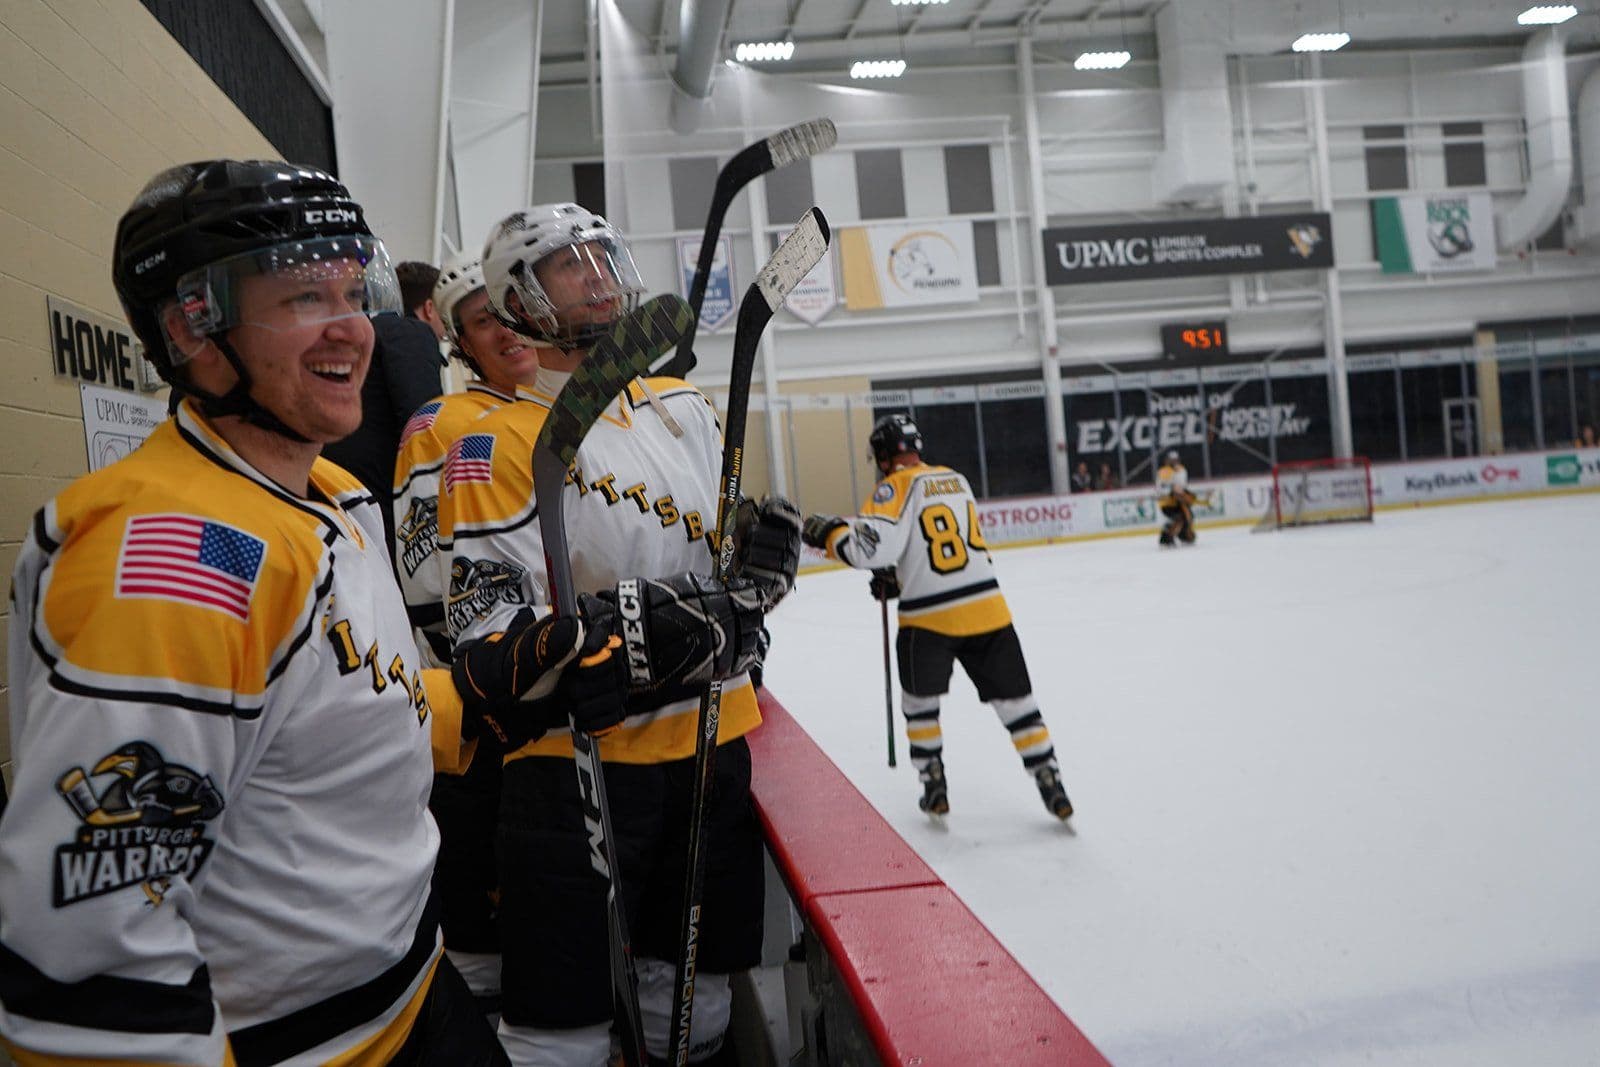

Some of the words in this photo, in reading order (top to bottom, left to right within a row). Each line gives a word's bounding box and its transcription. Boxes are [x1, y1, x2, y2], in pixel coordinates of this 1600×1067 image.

[305, 209, 357, 224] CCM
[135, 251, 166, 275] CCM
[1056, 238, 1150, 269] UPMC
[53, 310, 135, 391] HOME
[95, 398, 129, 425] UPMC
[1077, 411, 1205, 453] EXCEL
[1405, 471, 1478, 492] KeyBank
[565, 456, 720, 555] ITTSB
[322, 594, 429, 728] ITTS
